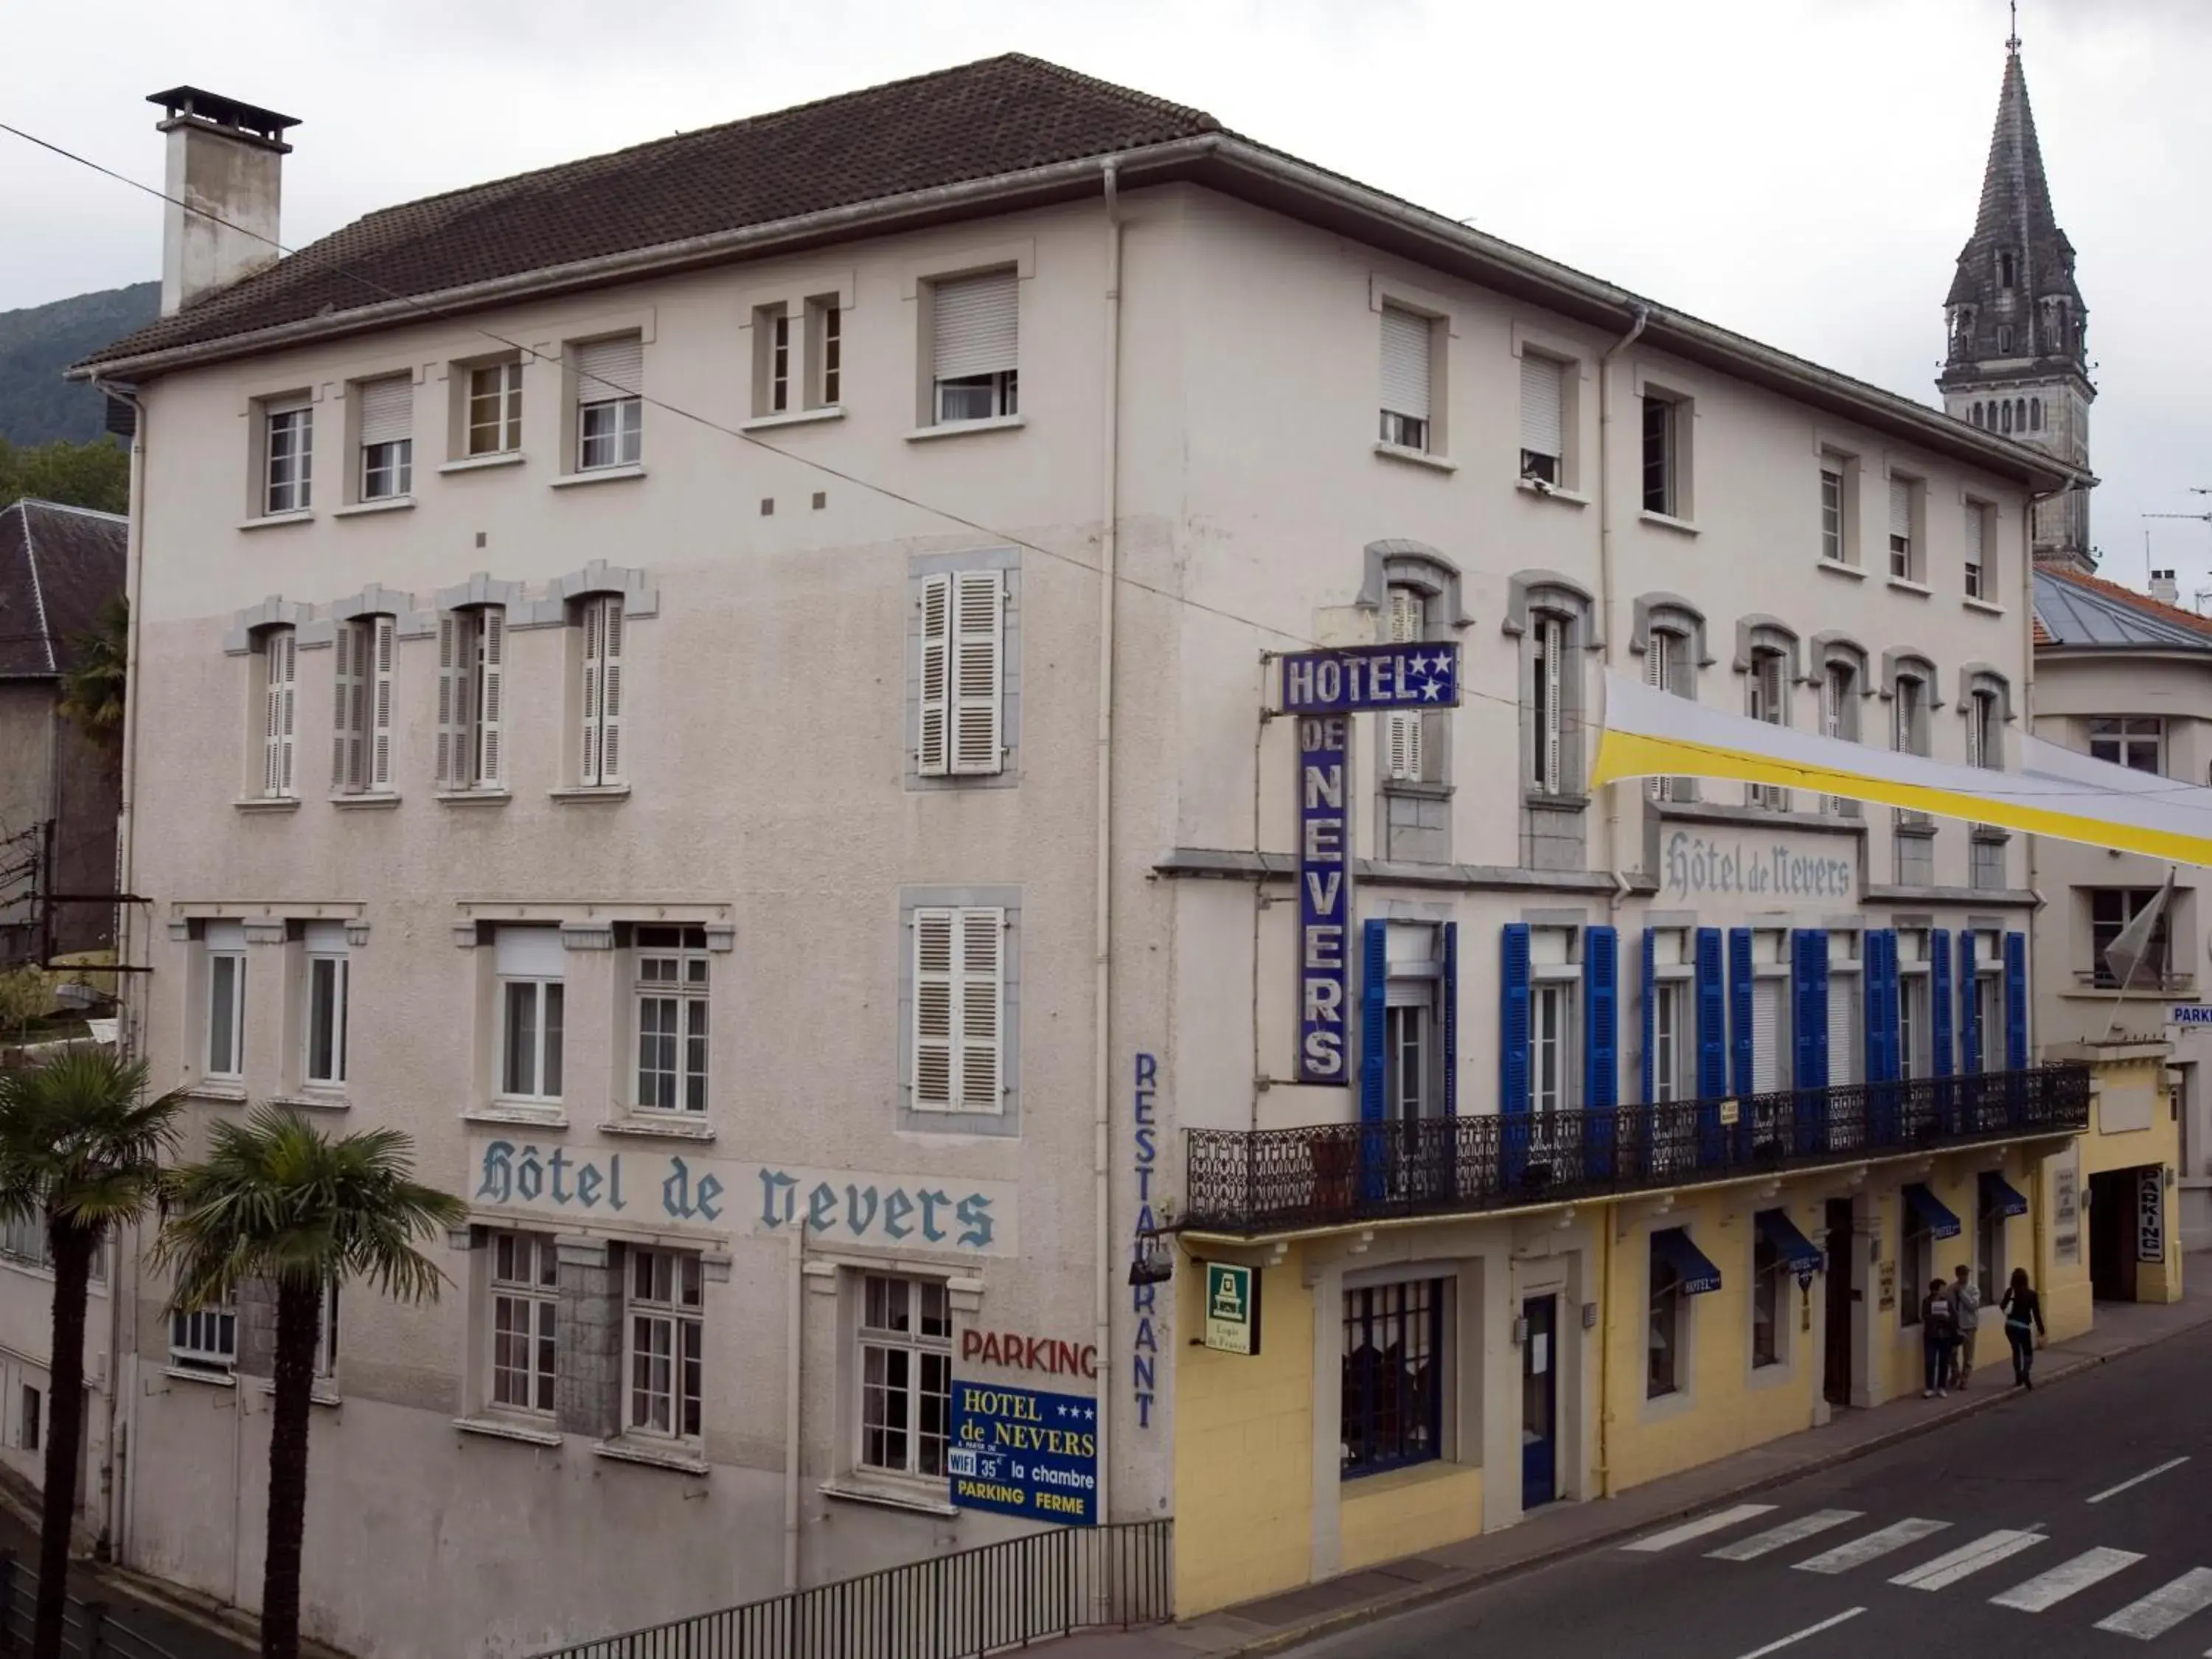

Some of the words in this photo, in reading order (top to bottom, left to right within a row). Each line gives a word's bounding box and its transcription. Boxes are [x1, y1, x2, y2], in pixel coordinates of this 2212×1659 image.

[1289, 655, 1418, 705] HOTEL
[1302, 718, 1344, 752] DE
[1666, 831, 1743, 901] Hôtel
[1748, 850, 1769, 893] de
[1773, 844, 1851, 897] Nevers
[1304, 764, 1343, 1076] NEVERS
[476, 1141, 627, 1211] Hôtel
[662, 1155, 724, 1221] de
[759, 1167, 995, 1248] Nevers
[2141, 1169, 2160, 1250] PARKING
[962, 1329, 1097, 1380] PARKING
[964, 1388, 1042, 1422] HOTEL
[961, 1419, 984, 1441] de
[995, 1421, 1095, 1458] NEVERS
[950, 1453, 974, 1473] WIFI
[1012, 1461, 1024, 1479] la
[1032, 1464, 1094, 1489] chambre
[959, 1480, 1025, 1504] PARKING
[1035, 1492, 1084, 1514] FERME
